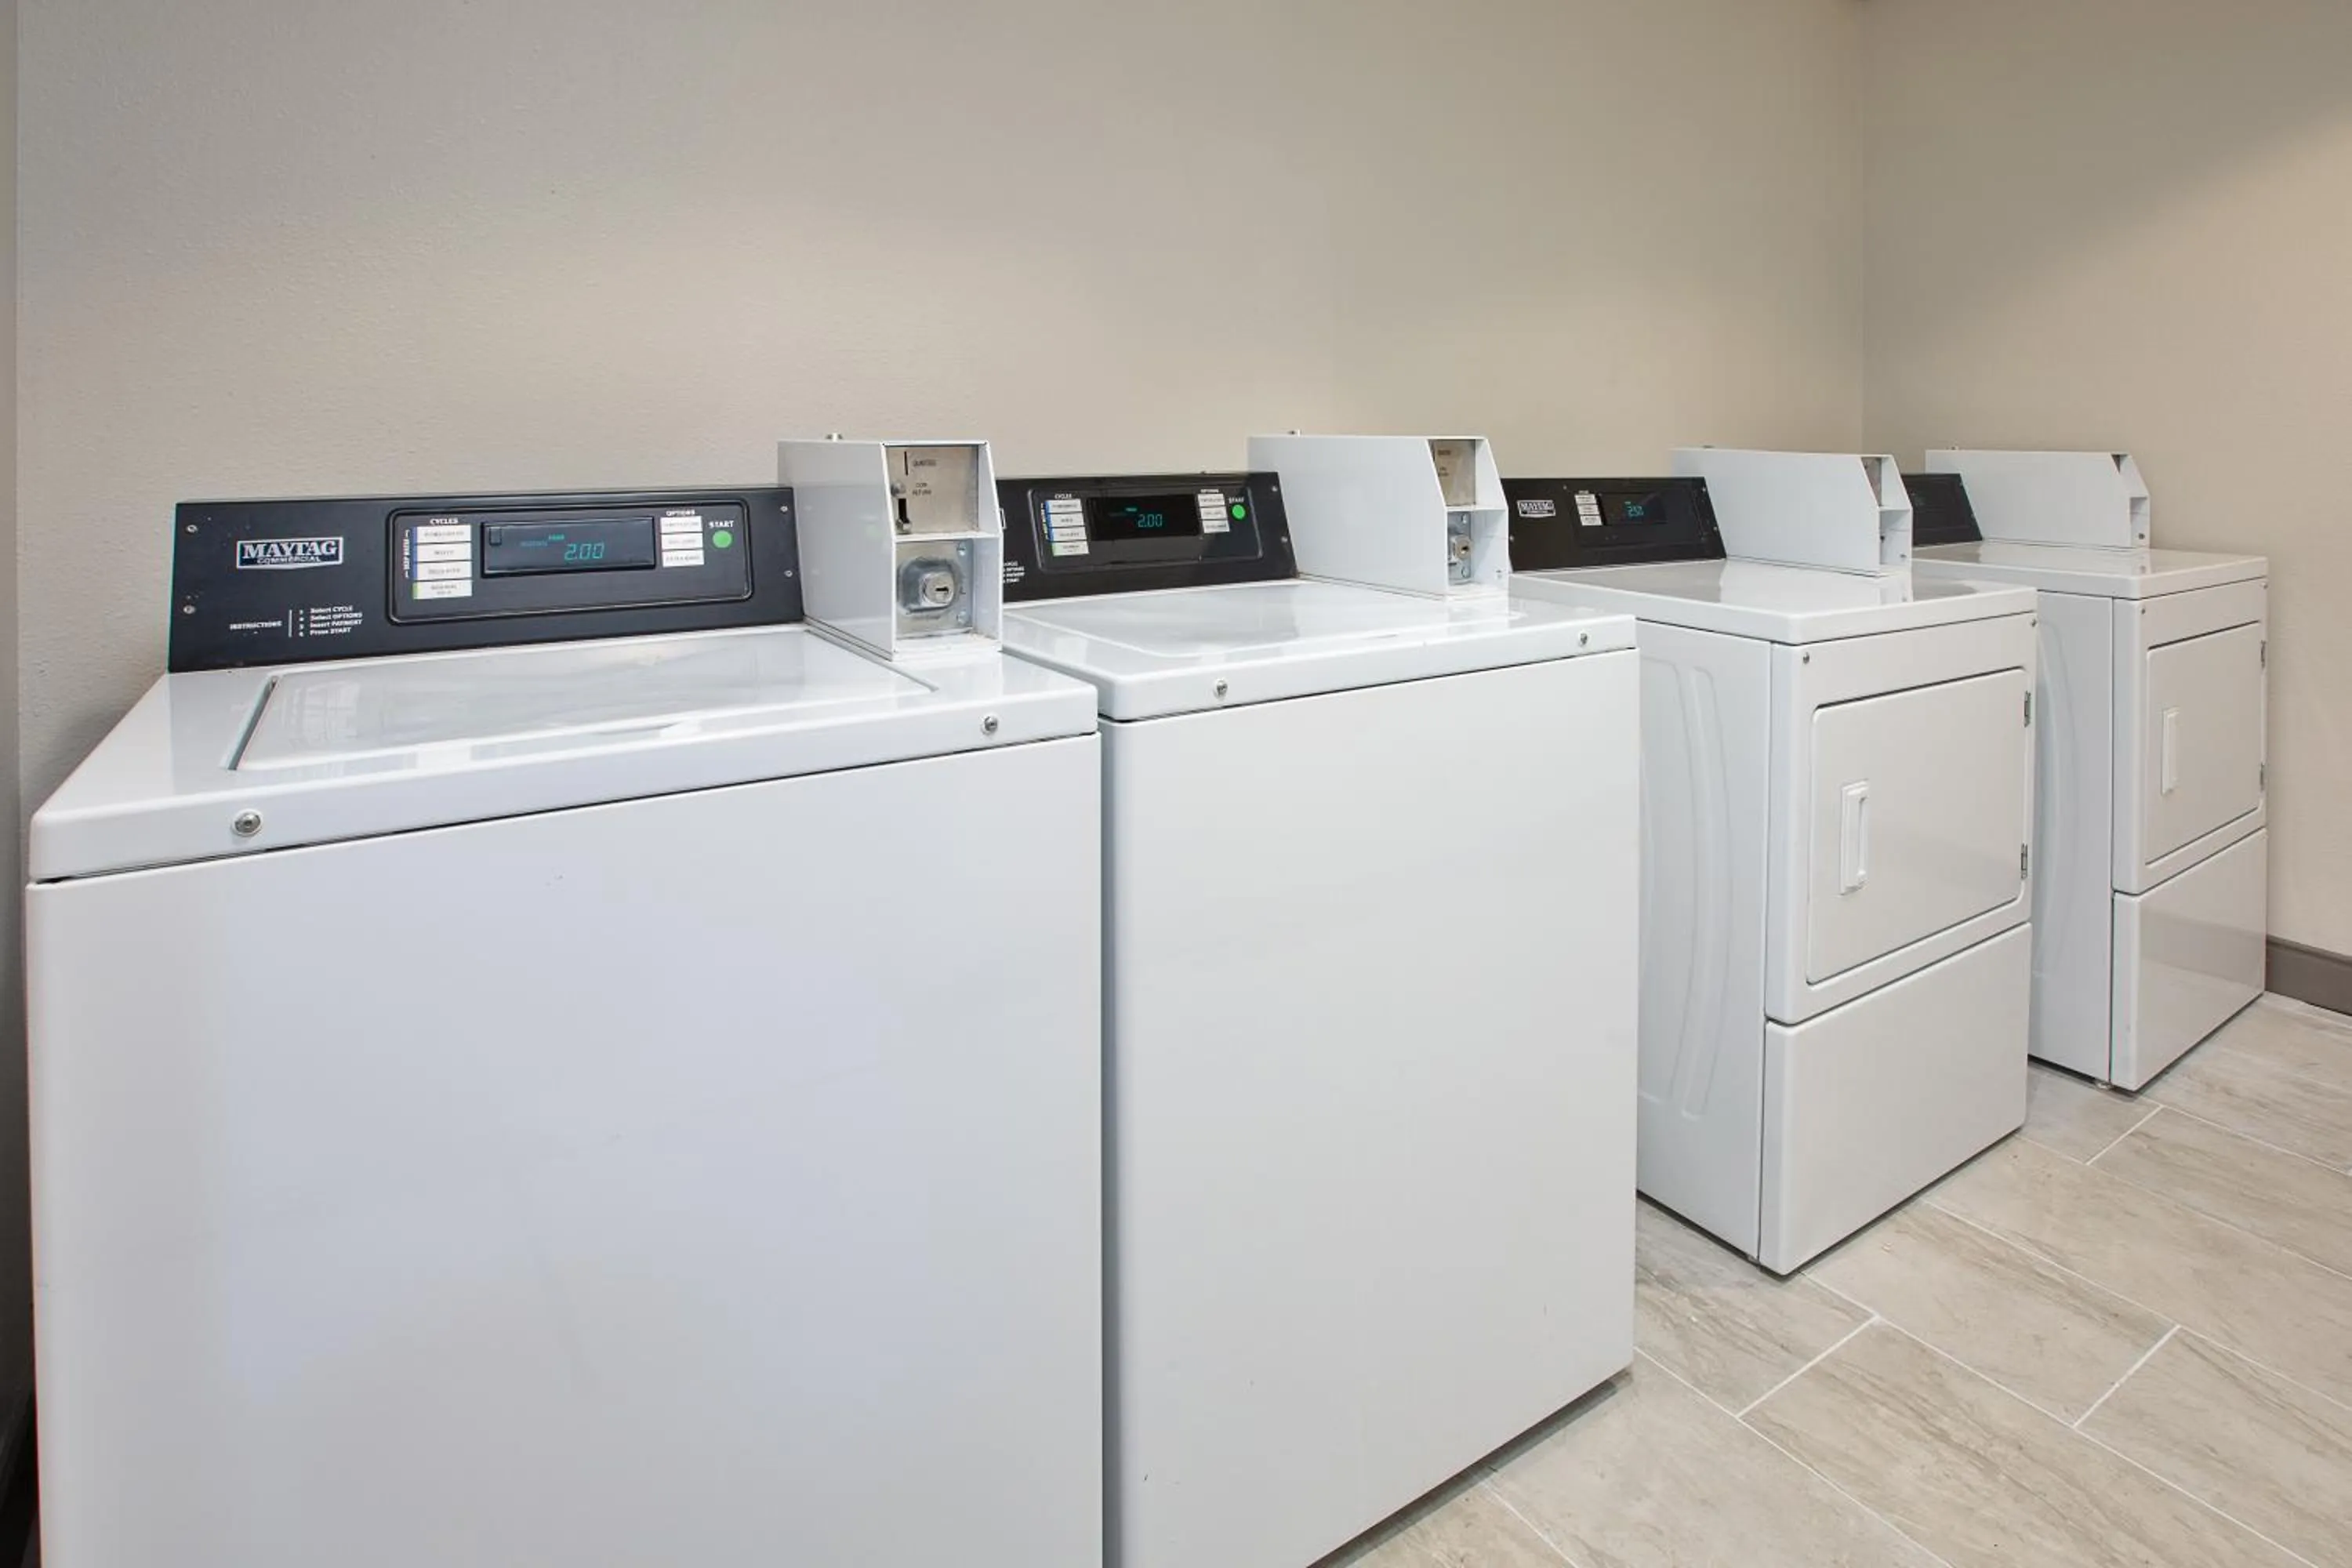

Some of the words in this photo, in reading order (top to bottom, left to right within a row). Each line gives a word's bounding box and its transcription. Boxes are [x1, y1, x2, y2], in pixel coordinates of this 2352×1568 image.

[709, 520, 735, 528] START
[242, 540, 338, 559] MAYTAG
[256, 556, 321, 564] COMMERCIAL
